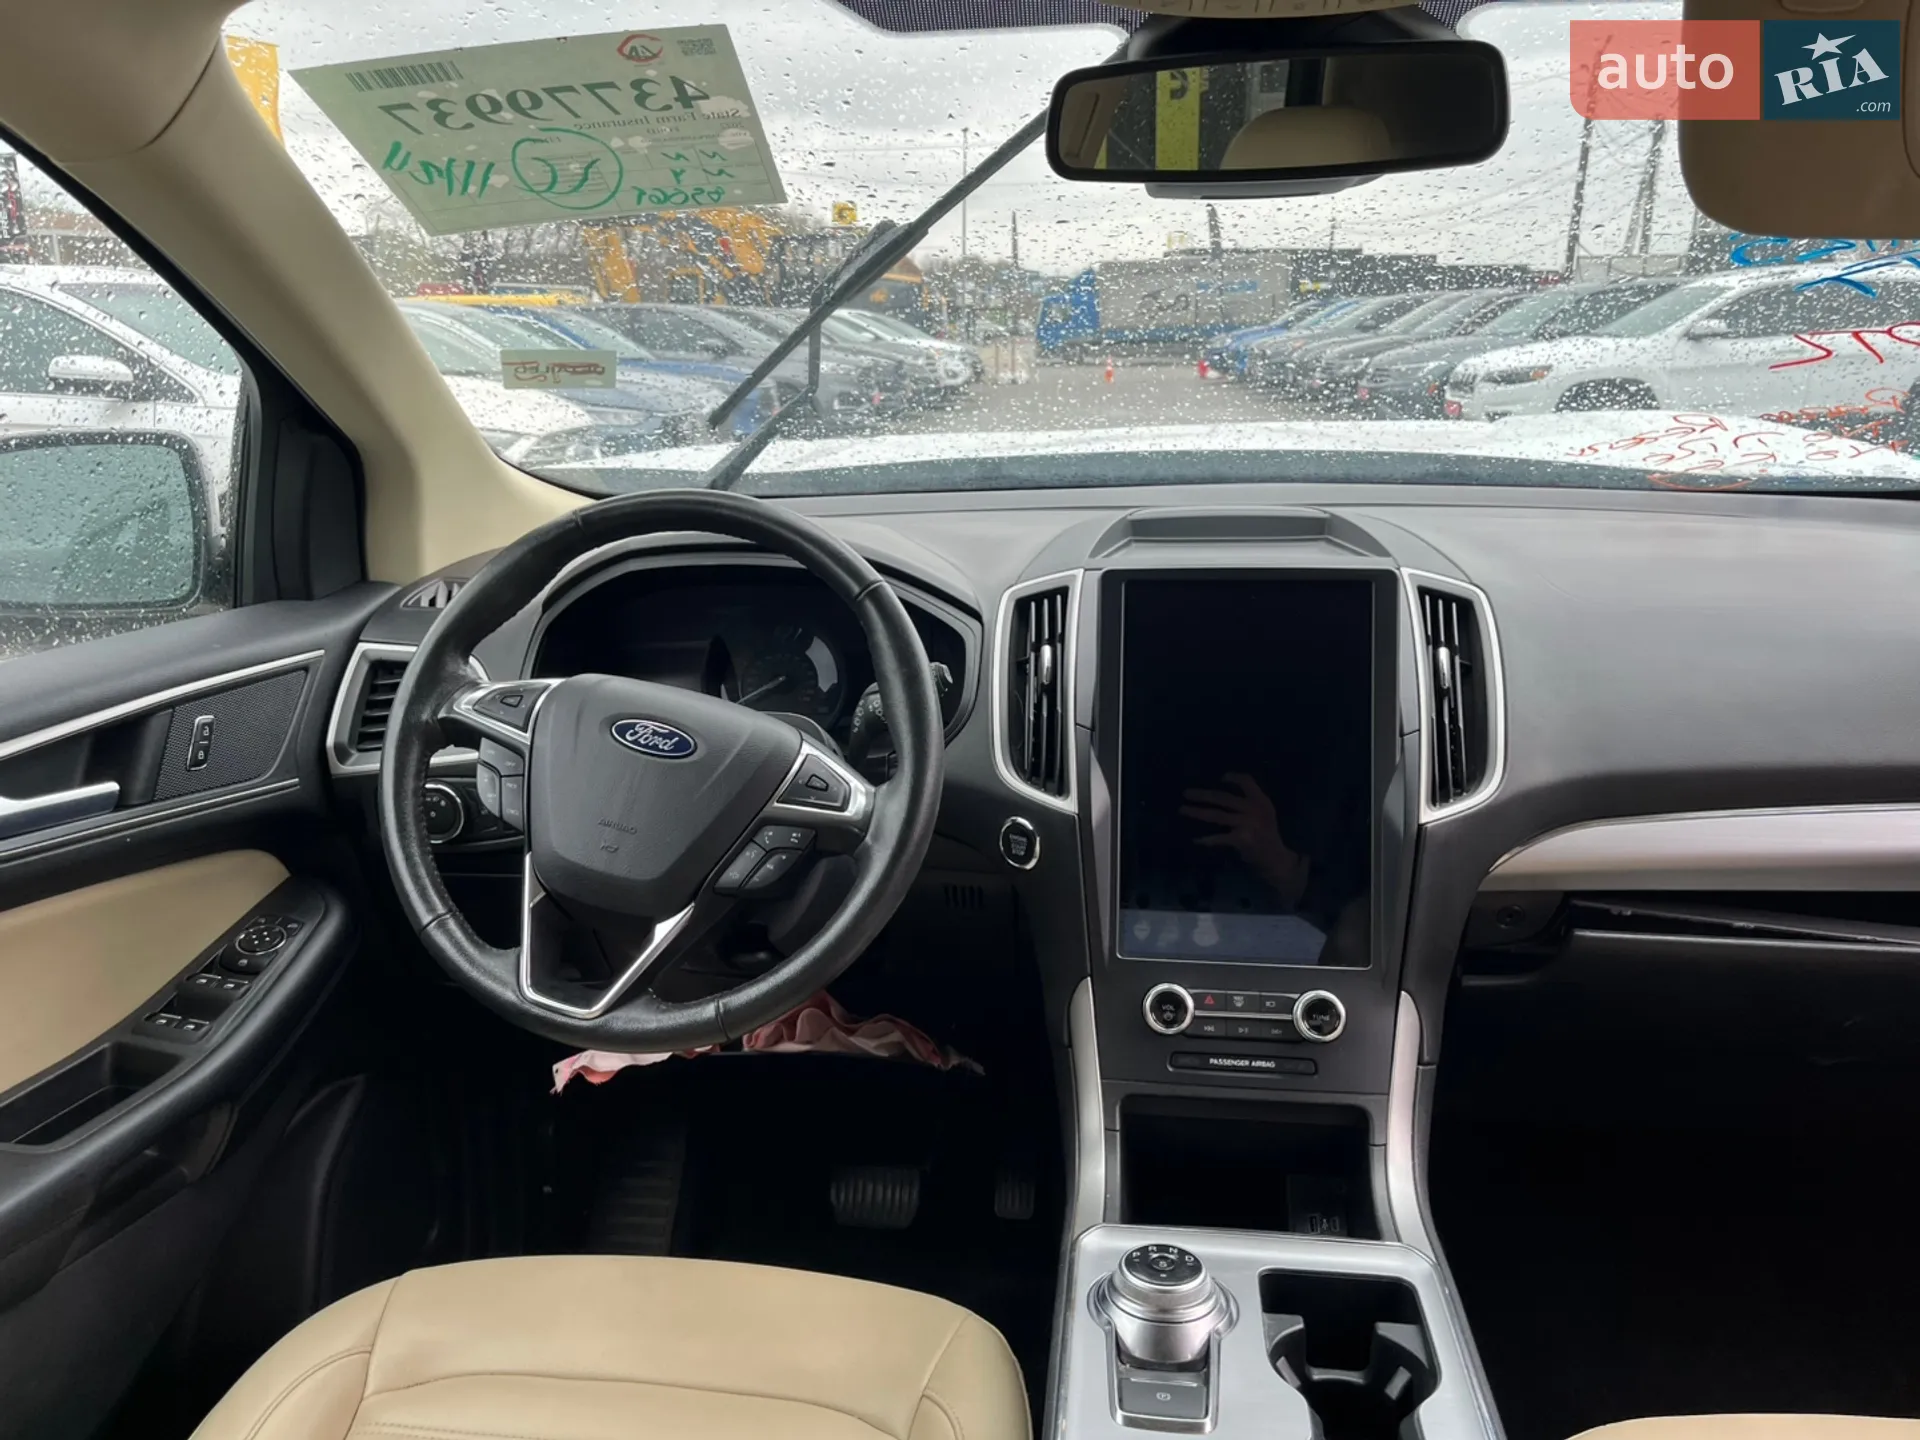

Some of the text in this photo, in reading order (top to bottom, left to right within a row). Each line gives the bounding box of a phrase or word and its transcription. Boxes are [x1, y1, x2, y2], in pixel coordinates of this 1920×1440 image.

[626, 722, 679, 752] Ford
[1209, 1057, 1276, 1068] PASSENGER AIRBAG
